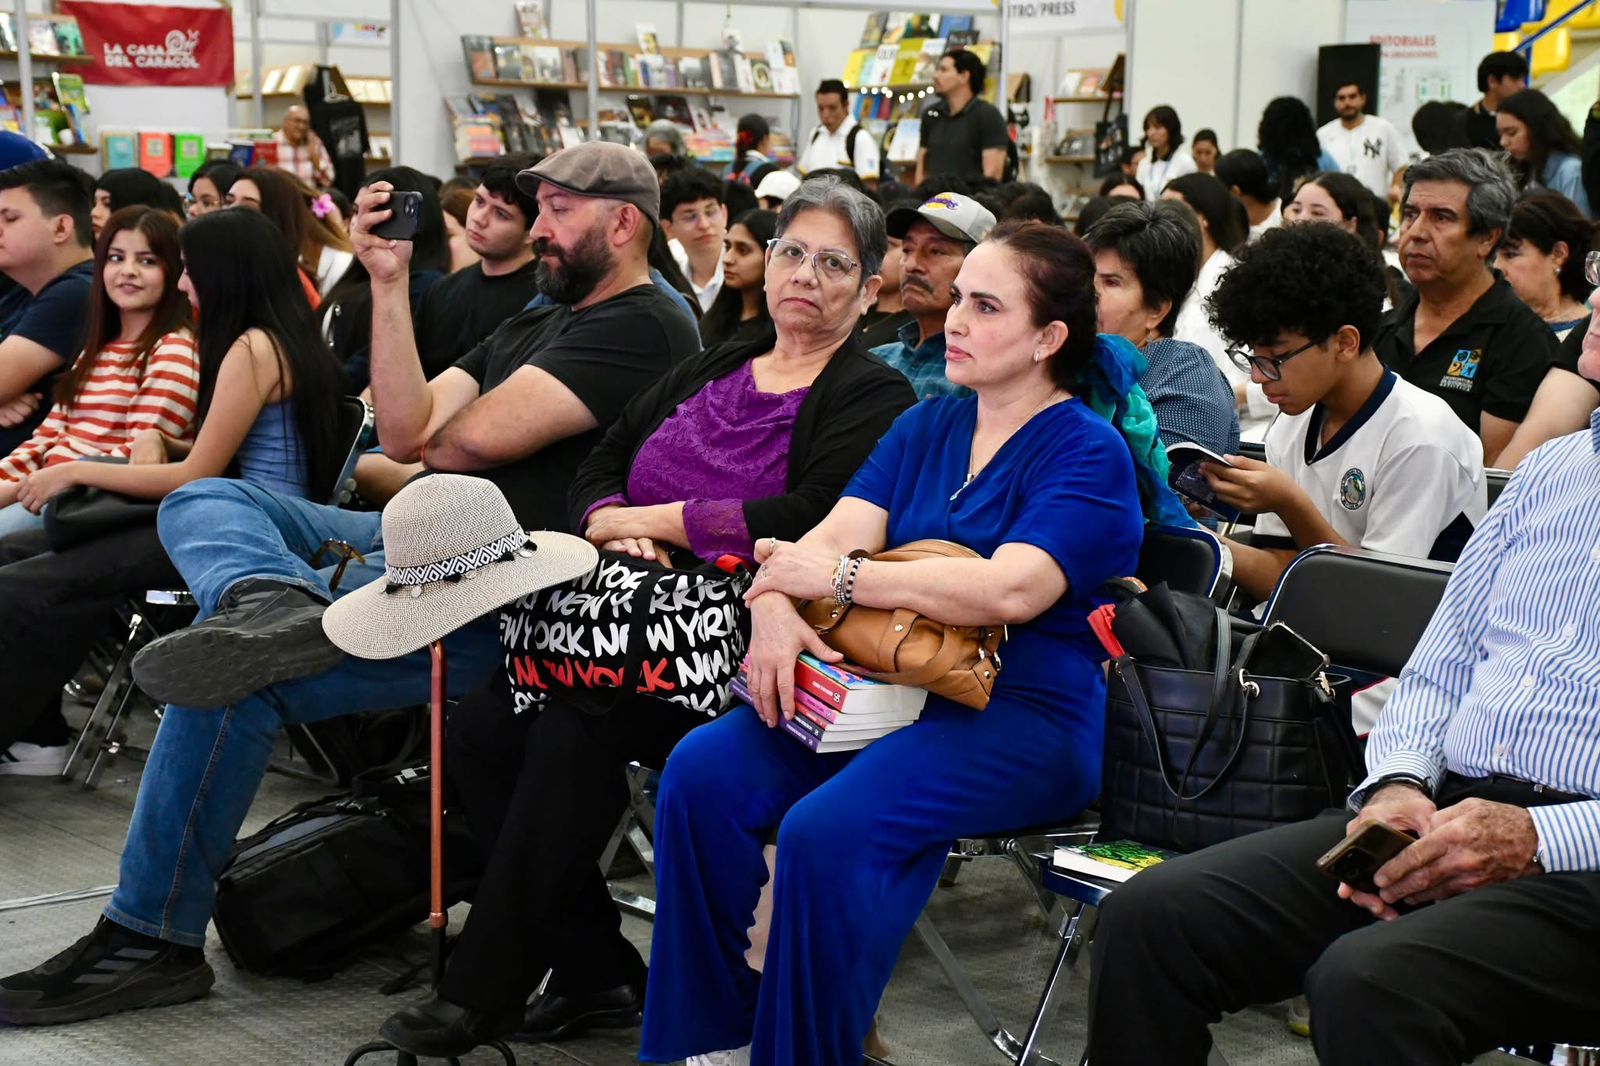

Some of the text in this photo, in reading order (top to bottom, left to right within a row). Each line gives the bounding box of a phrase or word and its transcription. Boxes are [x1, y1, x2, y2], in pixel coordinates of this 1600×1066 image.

[104, 42, 165, 57] LA CASA
[105, 54, 200, 69] DEL CARACOL
[1363, 137, 1382, 158] NY
[545, 590, 610, 620] NEW
